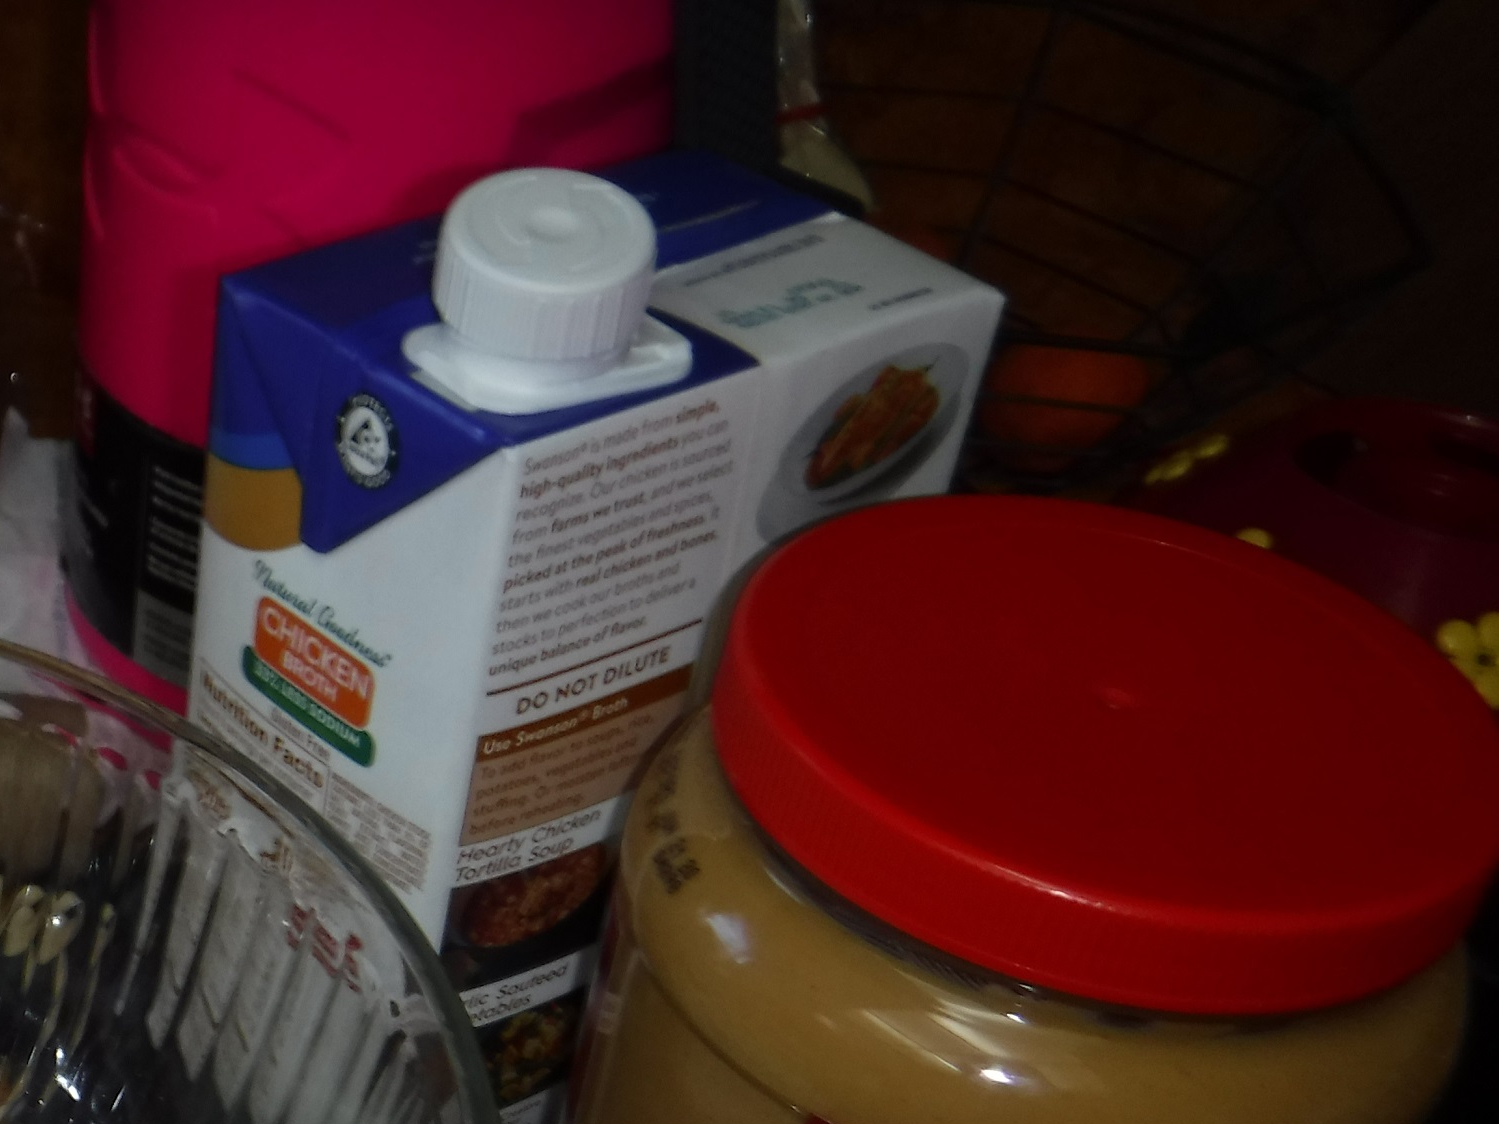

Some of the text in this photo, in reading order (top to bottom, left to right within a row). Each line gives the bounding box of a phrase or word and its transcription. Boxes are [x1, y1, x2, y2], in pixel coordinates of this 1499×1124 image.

[519, 420, 729, 500] high-quality ingredients you can
[603, 426, 639, 448] made
[642, 416, 673, 434] from
[590, 480, 617, 500] Our
[619, 463, 668, 489] chicken
[682, 438, 732, 466] sourced
[507, 551, 533, 569] the
[536, 537, 575, 560] finest
[578, 515, 645, 546] vegetables
[647, 503, 673, 520] and
[511, 526, 548, 545] from
[550, 512, 590, 534] farms
[592, 505, 611, 519] we
[649, 480, 675, 501] and
[676, 476, 696, 490] we
[254, 559, 319, 618] Natural
[499, 591, 542, 613] starts
[544, 580, 575, 599] with
[576, 566, 603, 588] real
[603, 553, 653, 579] chicken
[654, 540, 679, 562] and
[502, 562, 553, 595] picked
[555, 559, 568, 575] at
[571, 552, 595, 569] the
[595, 538, 628, 565] peak
[629, 529, 646, 549] of
[491, 632, 538, 655] stocks
[541, 626, 557, 642] to
[558, 602, 628, 637] perfection
[629, 597, 644, 612] to
[495, 615, 531, 635] then
[532, 608, 553, 623] we
[554, 595, 588, 617] cook
[589, 588, 612, 605] our
[657, 561, 681, 581] and
[263, 608, 371, 700] CHICKEN
[282, 649, 338, 703] BROTH
[488, 655, 538, 677] unique
[540, 635, 592, 662] balance
[592, 624, 611, 644] of
[516, 644, 673, 716] DO NOT DILUTE
[202, 670, 270, 748] Nutrition
[273, 735, 325, 789] Facts
[308, 702, 363, 749] SODIUM
[483, 736, 512, 756] Use
[592, 698, 629, 721] Broth
[454, 836, 575, 883] Tortilla Soup
[457, 809, 603, 865] Hearty Chicken
